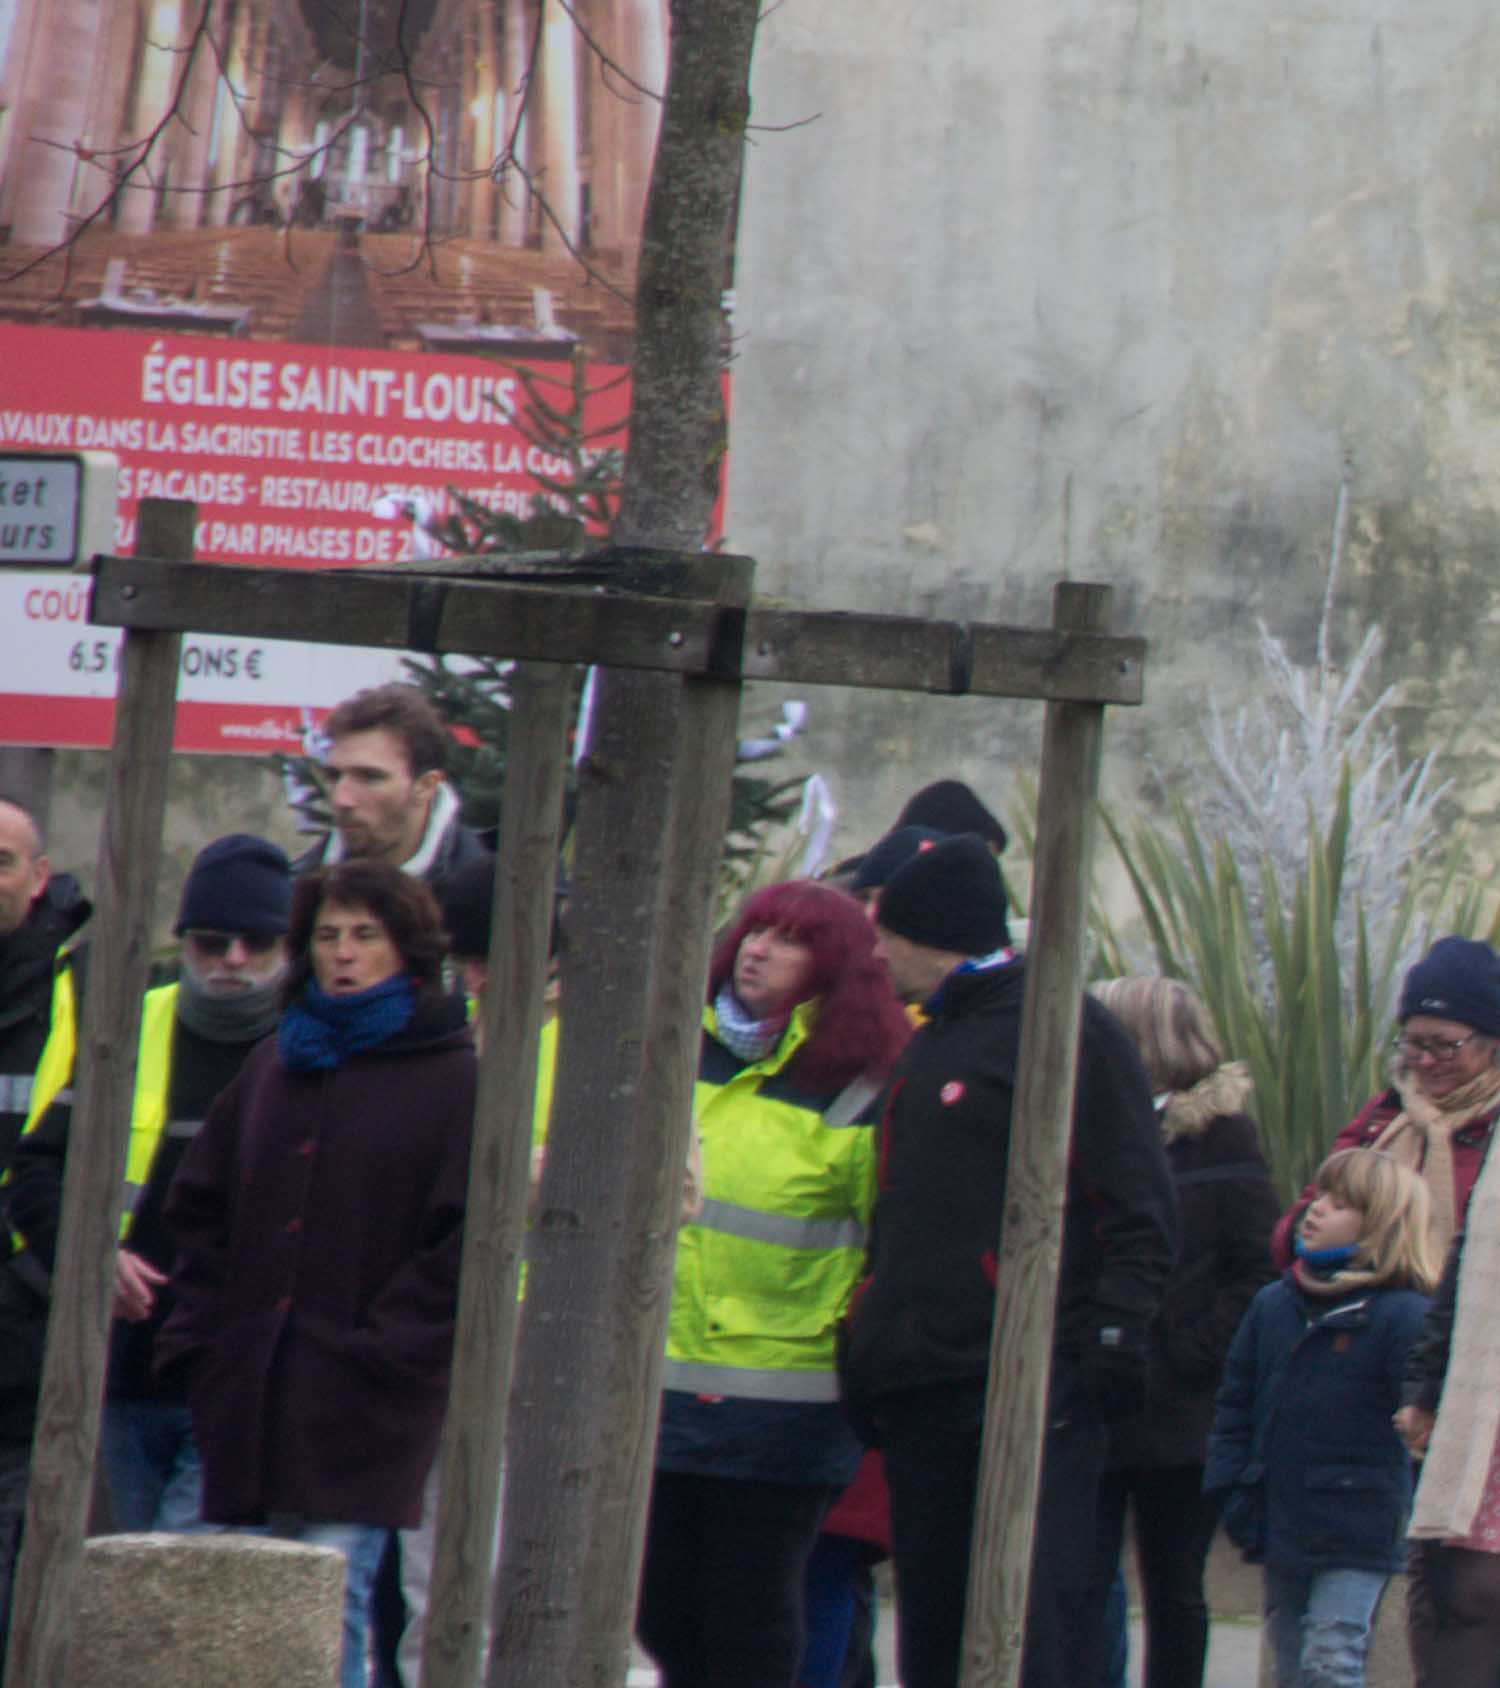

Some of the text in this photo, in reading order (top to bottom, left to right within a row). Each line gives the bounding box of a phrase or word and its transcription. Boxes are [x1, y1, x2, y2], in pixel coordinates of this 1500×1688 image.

[141, 341, 517, 425] ÉGLISE SAINT-LOUIS
[0, 411, 72, 446] VAUX
[76, 418, 145, 450] DANS
[147, 421, 176, 452] LA
[309, 430, 353, 464] LES
[356, 435, 489, 473] CLOCHERS,
[492, 446, 522, 473] LA
[210, 520, 258, 552] PAR
[261, 523, 352, 561] PHASES
[354, 528, 392, 562] DE
[25, 581, 87, 622] COÛ
[245, 648, 263, 679] €
